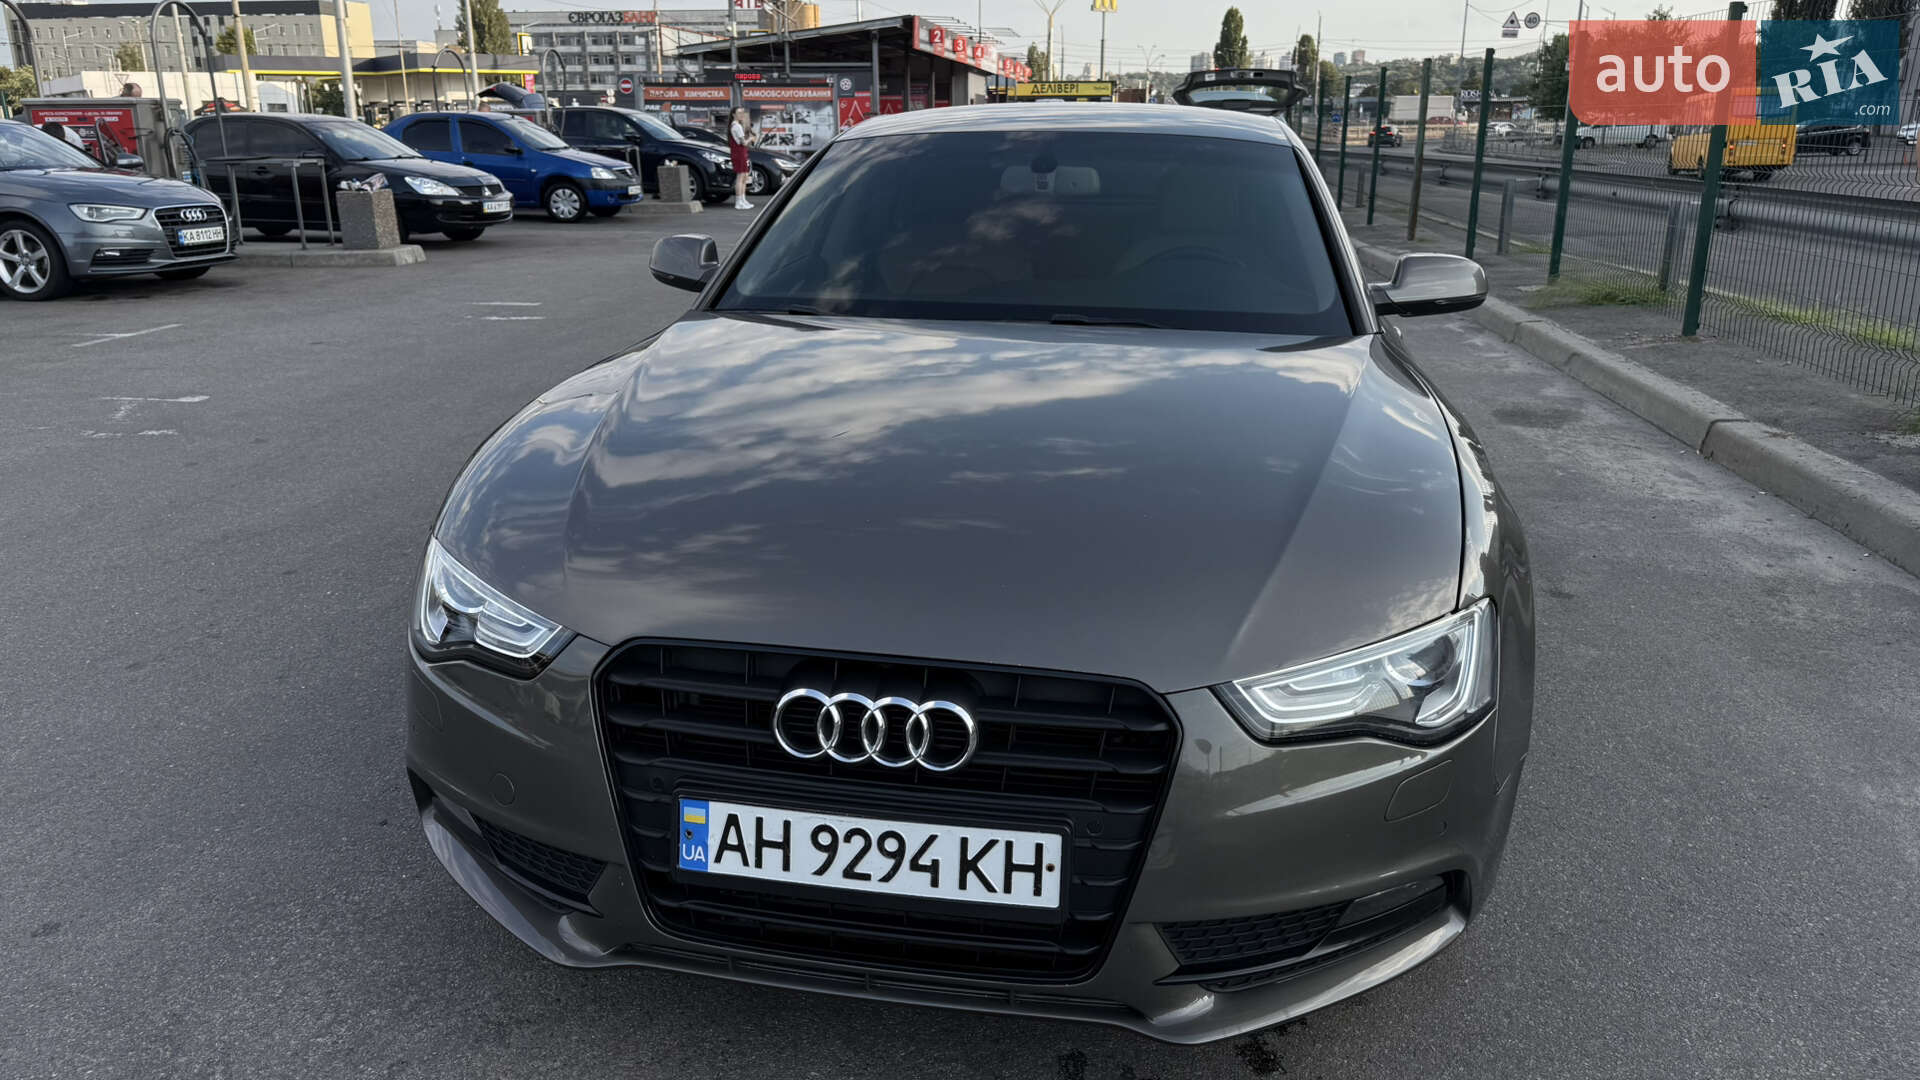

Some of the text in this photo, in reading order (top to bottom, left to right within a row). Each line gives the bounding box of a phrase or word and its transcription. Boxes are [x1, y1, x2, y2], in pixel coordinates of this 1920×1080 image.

[1527, 16, 1538, 25] 40
[934, 30, 942, 43] 2
[956, 40, 963, 51] 3
[975, 47, 982, 56] 4
[1031, 83, 1079, 94] ДЕЛІВЕРІ
[682, 843, 706, 863] UA
[713, 812, 1045, 897] AH 9294 KH
